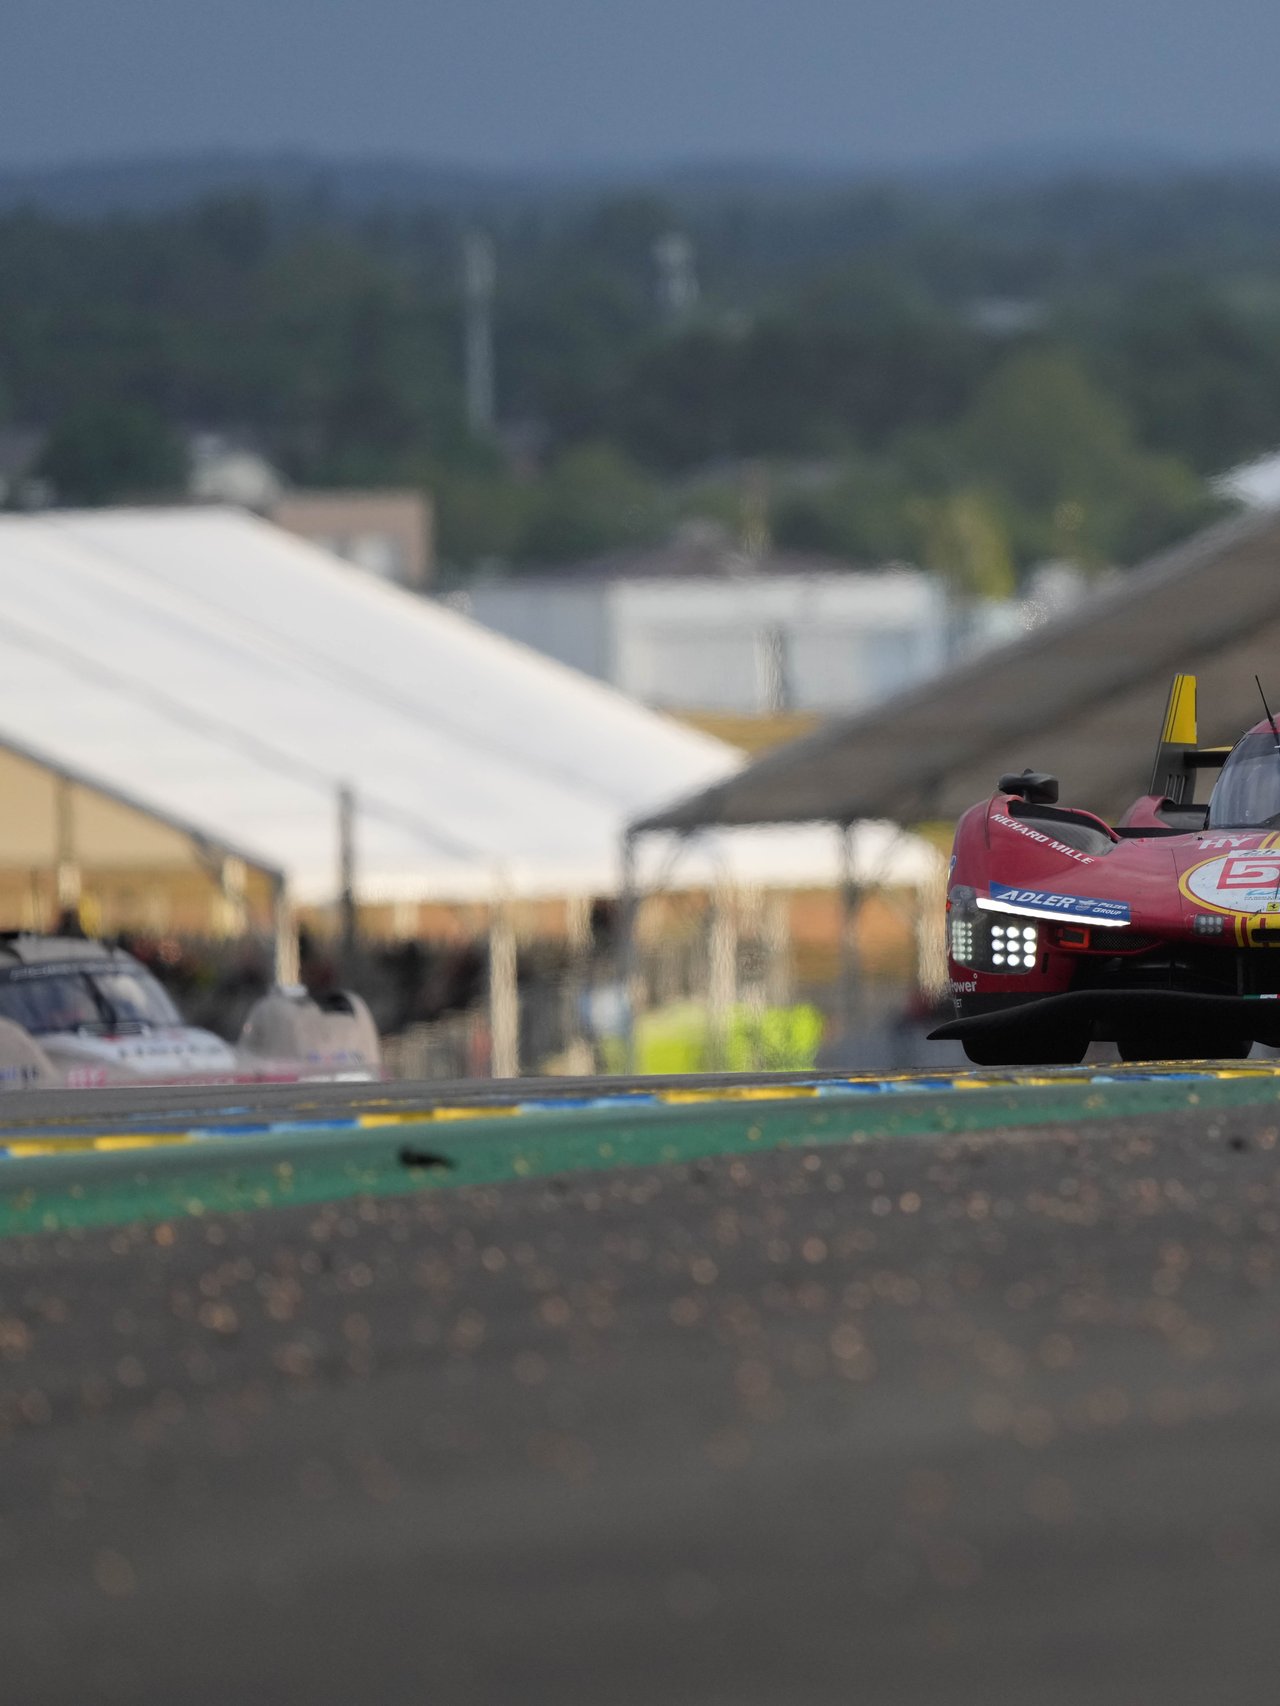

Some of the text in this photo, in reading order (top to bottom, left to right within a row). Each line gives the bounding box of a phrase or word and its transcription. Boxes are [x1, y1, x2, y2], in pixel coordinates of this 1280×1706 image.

[990, 813, 1095, 865] RICHARD MILLE
[996, 890, 1076, 909] ADLER
[1092, 907, 1123, 916] GROUP
